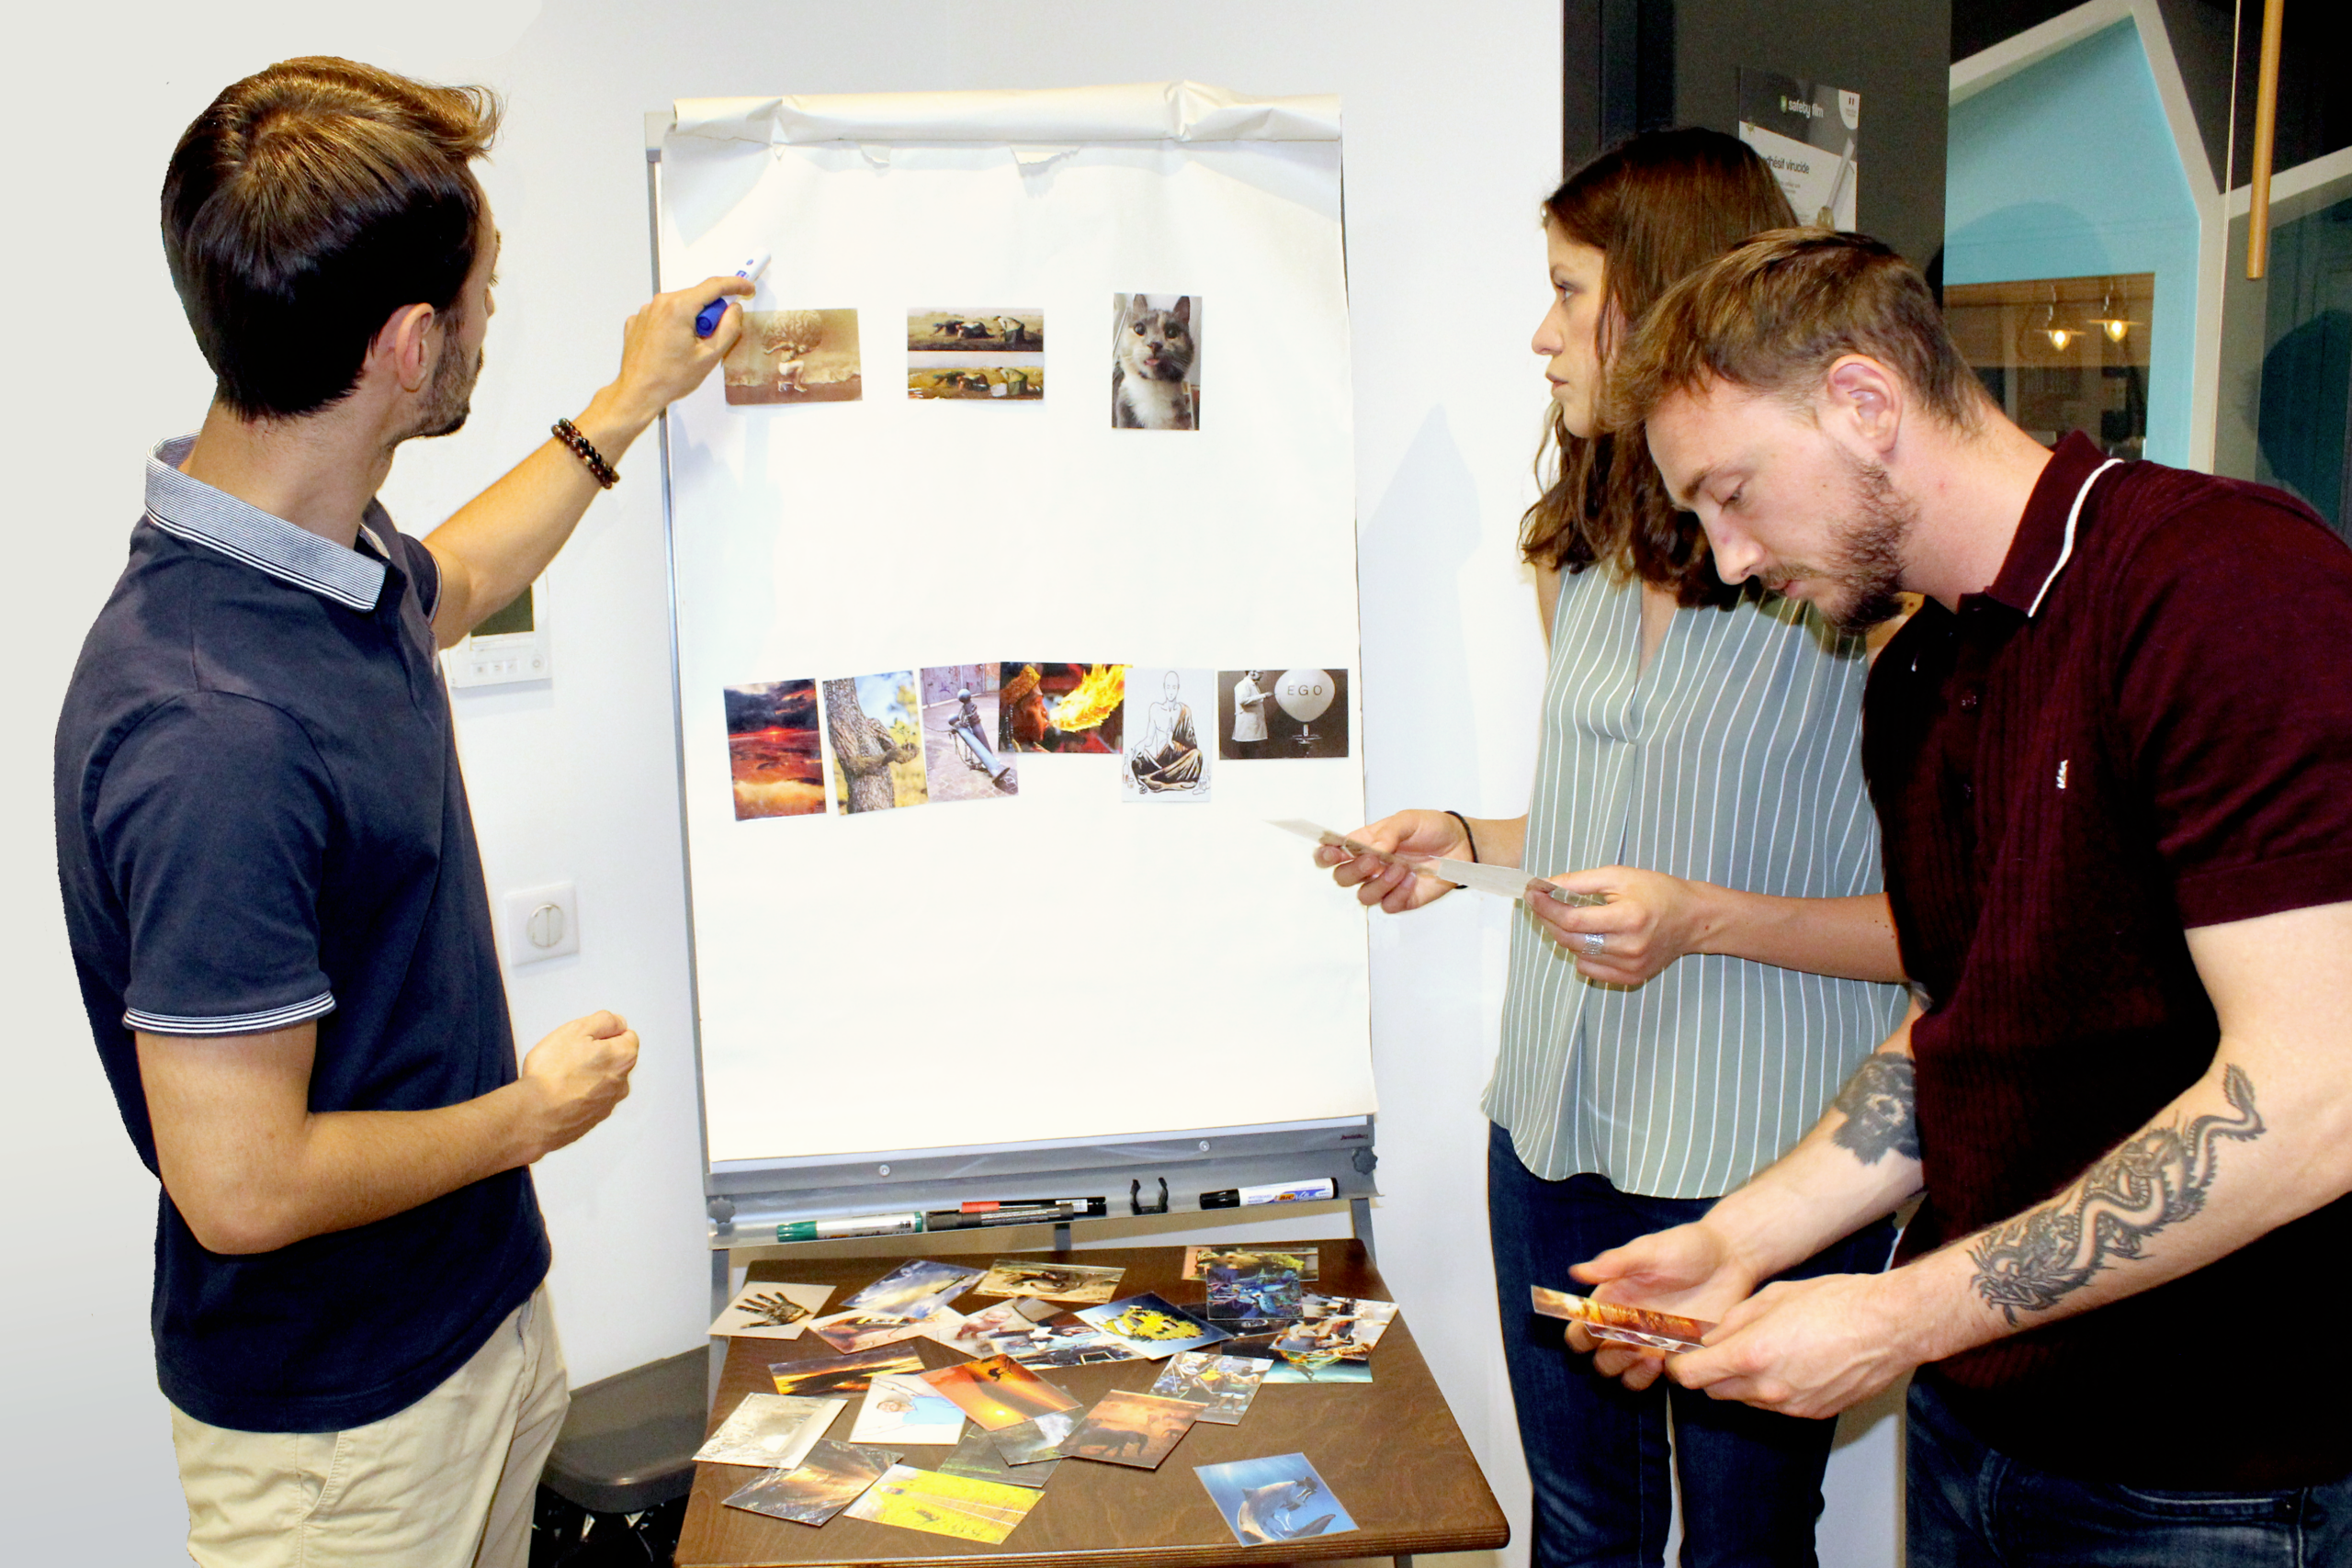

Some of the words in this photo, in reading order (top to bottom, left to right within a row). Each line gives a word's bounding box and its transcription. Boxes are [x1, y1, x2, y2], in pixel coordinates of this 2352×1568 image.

[1812, 103, 1824, 118] film
[1786, 159, 1810, 174] virucide
[1287, 684, 1322, 695] EGO
